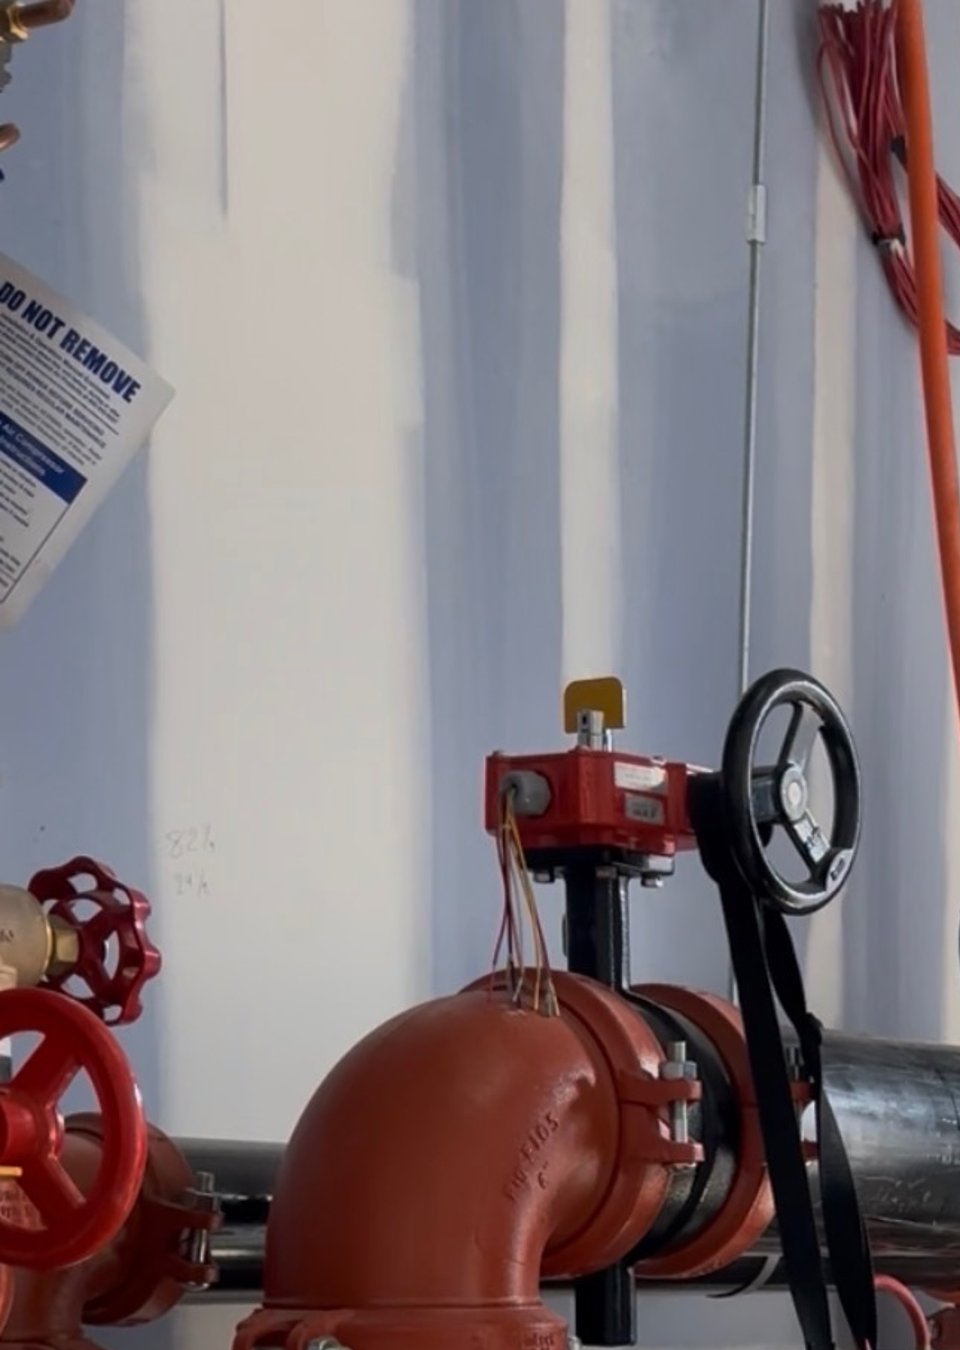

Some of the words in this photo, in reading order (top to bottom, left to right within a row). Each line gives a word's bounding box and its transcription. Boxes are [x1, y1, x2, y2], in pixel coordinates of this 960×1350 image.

[0, 281, 26, 312] DO
[21, 300, 66, 340] NOT
[59, 328, 142, 404] REMOVE
